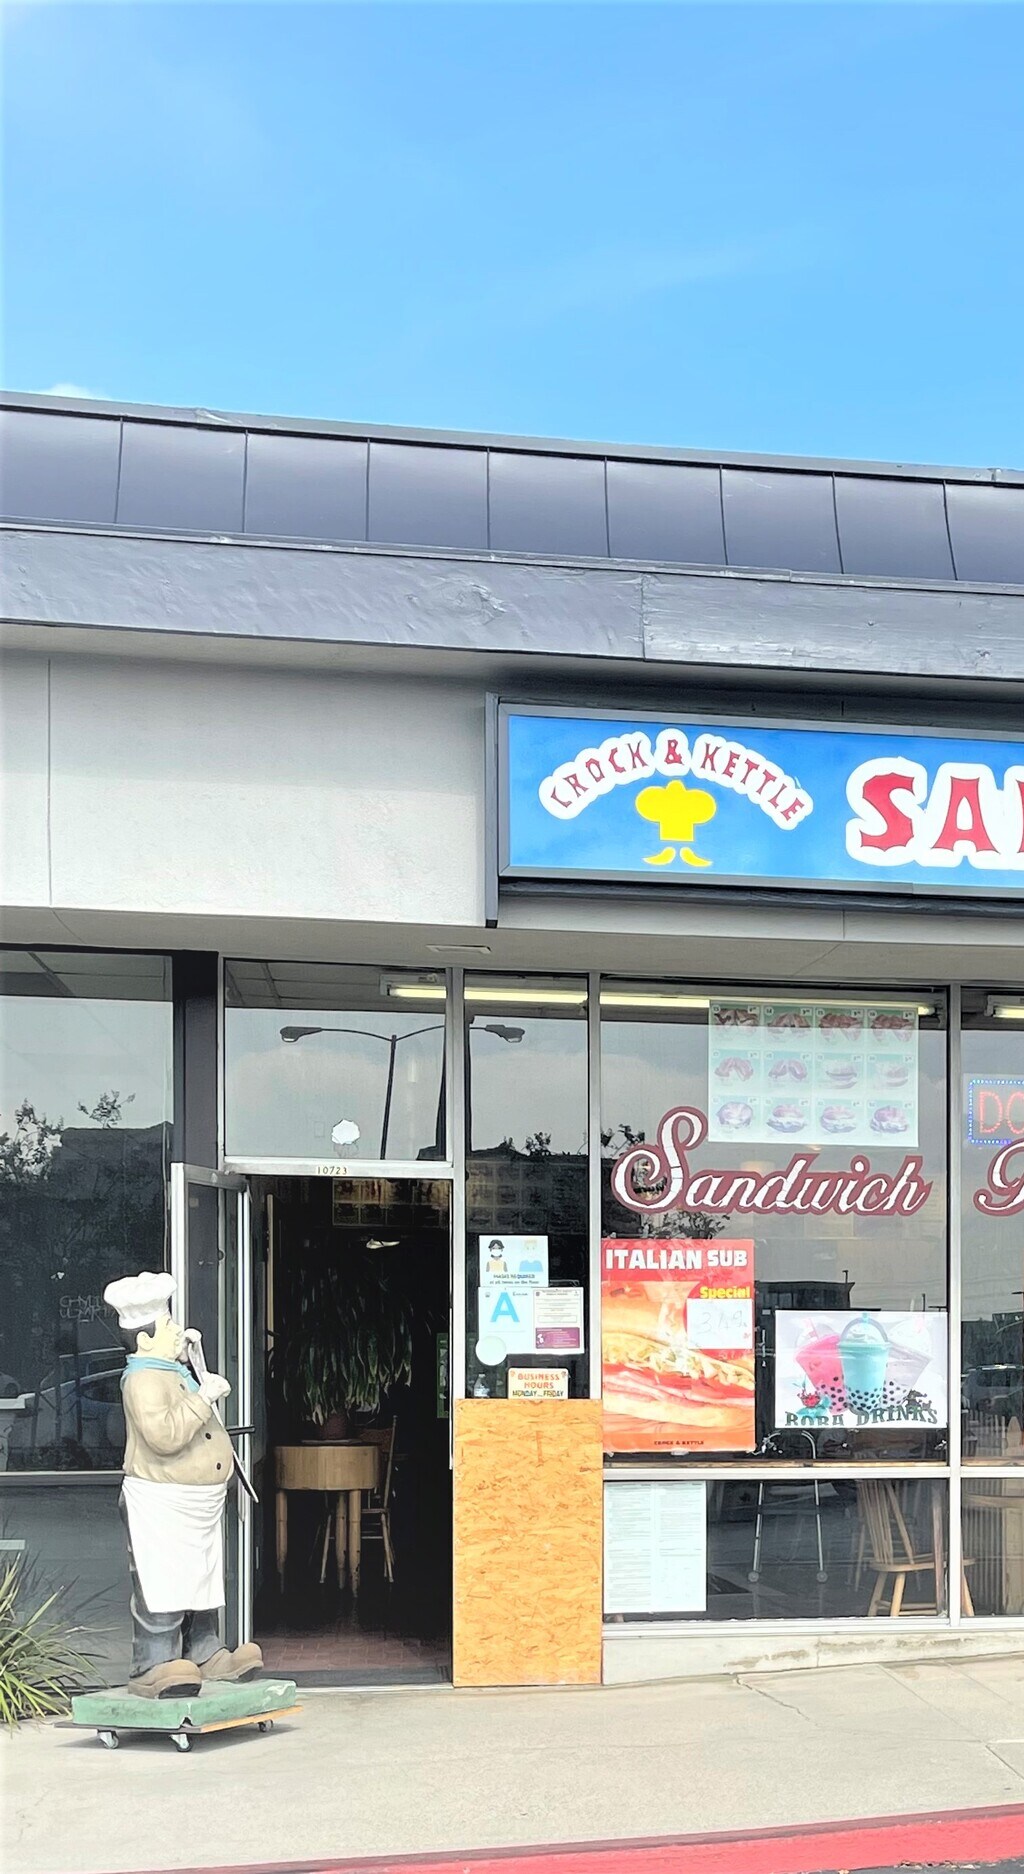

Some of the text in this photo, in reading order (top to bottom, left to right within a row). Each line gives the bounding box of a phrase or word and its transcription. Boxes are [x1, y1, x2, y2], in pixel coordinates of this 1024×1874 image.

[550, 738, 806, 822] CROCK & KETTLE
[611, 1106, 933, 1216] Sandwich
[317, 1166, 347, 1175] 10723
[605, 1249, 748, 1270] ITALIAN SUB
[699, 1285, 751, 1299] Special
[490, 1292, 521, 1323] A
[517, 1373, 560, 1381] BUSINESS
[512, 1390, 564, 1398] MONDAY FRIDAY
[524, 1382, 554, 1390] HOURS
[856, 1404, 939, 1427] DRINKS
